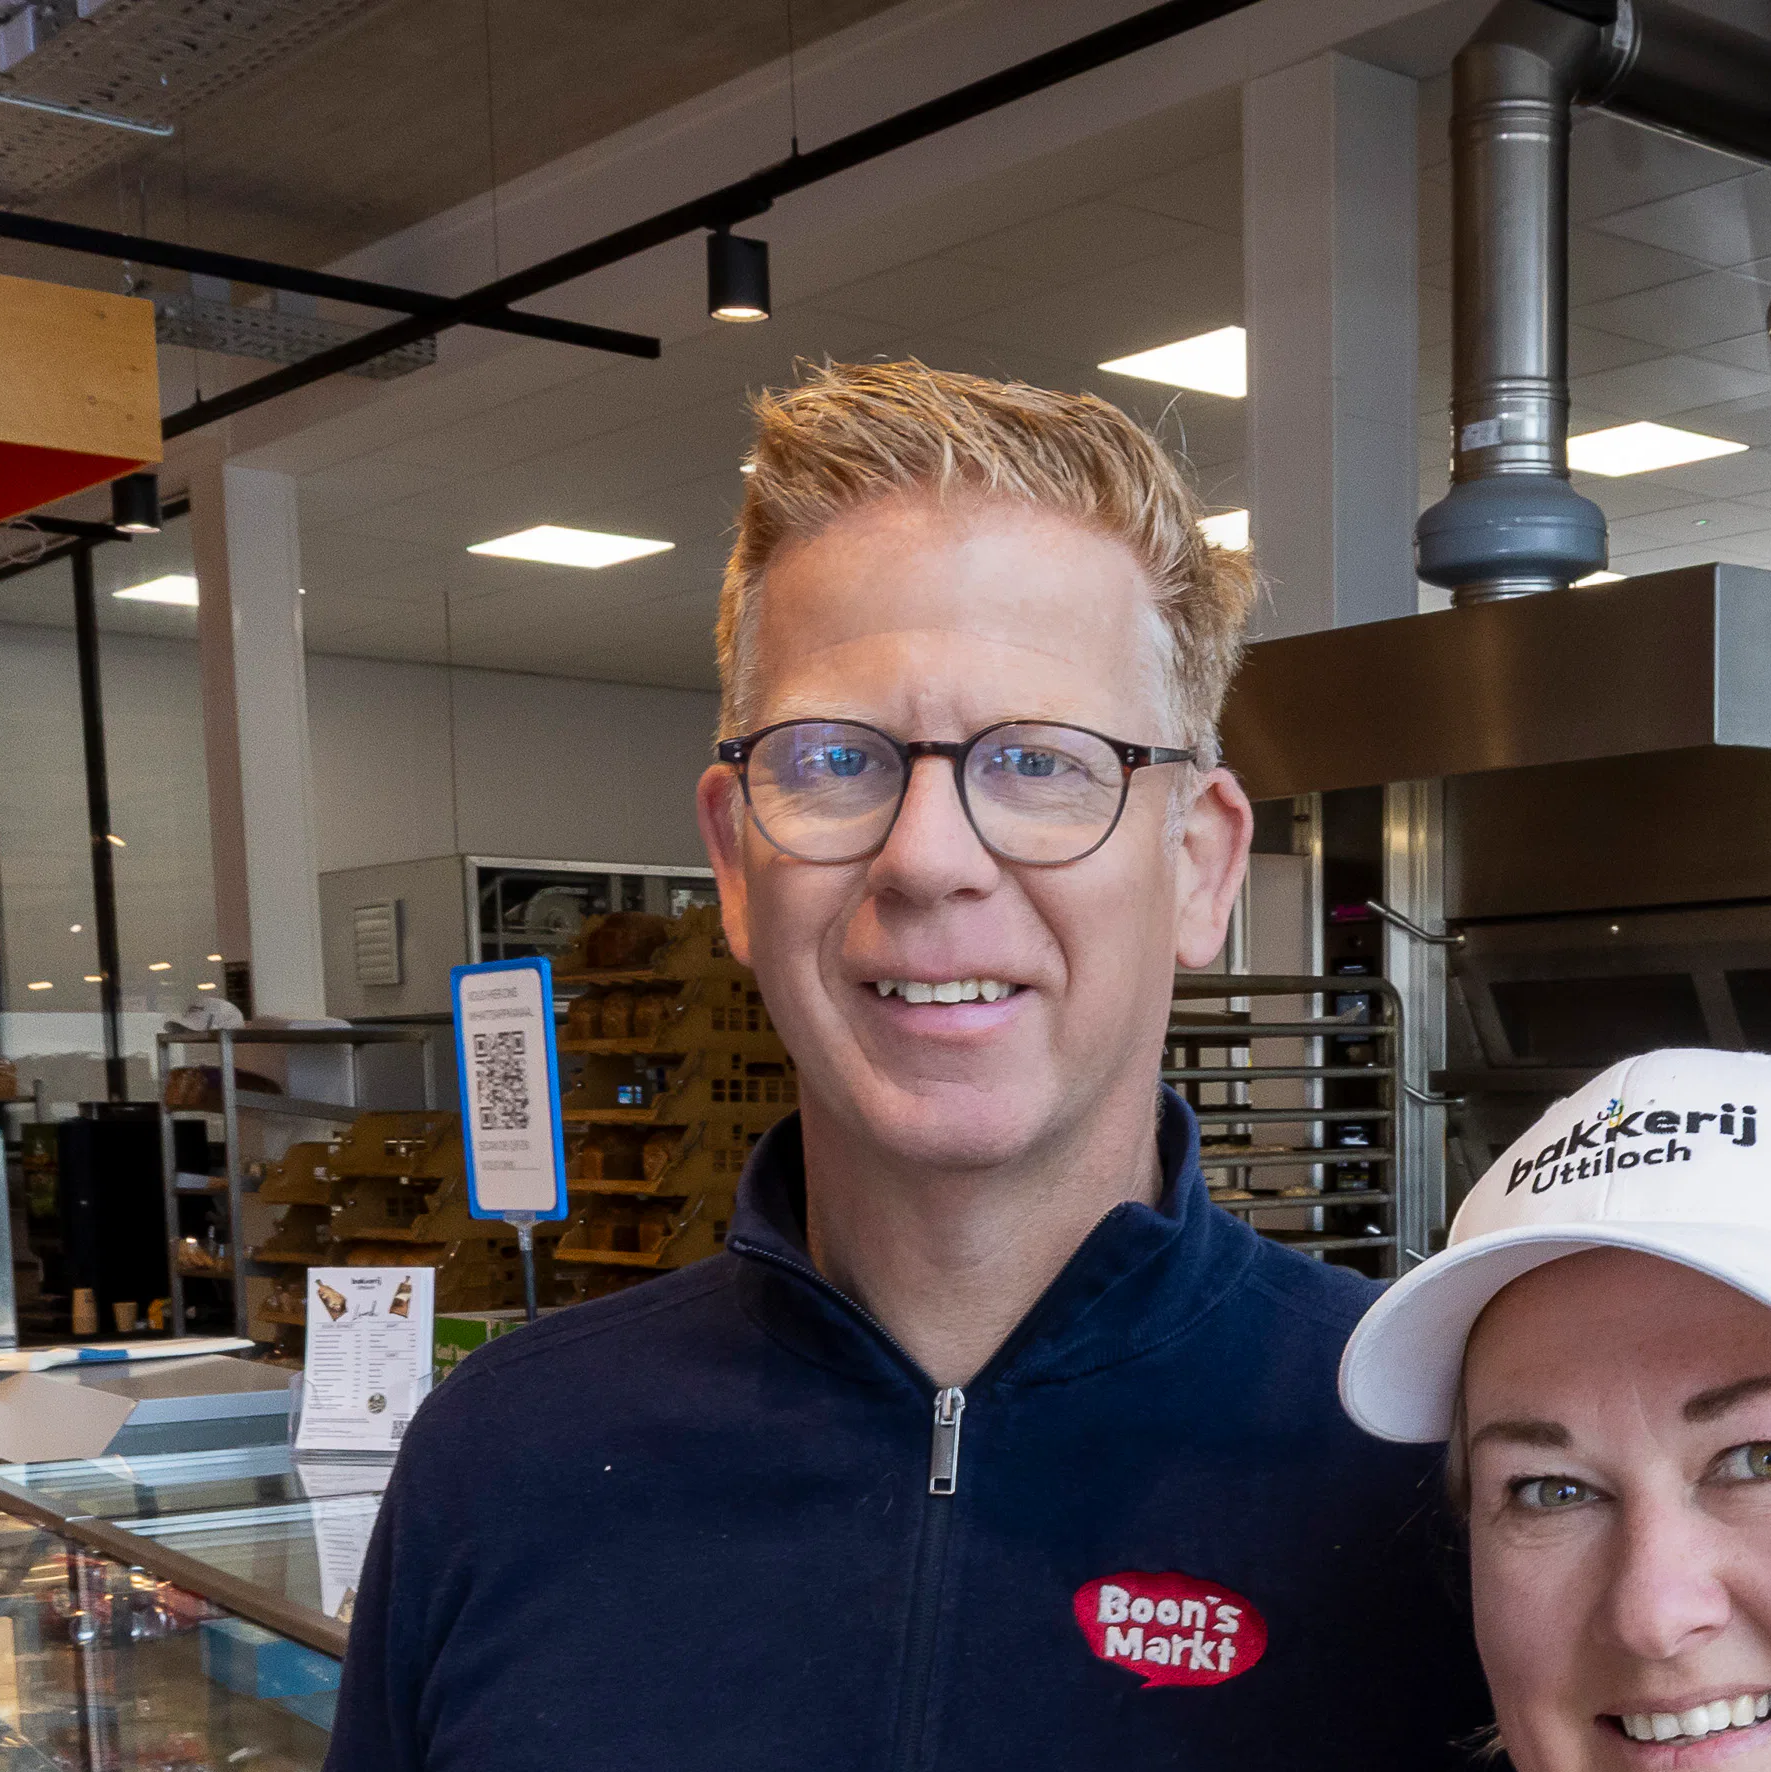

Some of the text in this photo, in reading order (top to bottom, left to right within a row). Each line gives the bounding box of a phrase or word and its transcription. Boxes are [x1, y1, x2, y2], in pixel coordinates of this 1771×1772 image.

[1505, 1102, 1757, 1197] bakkerij
[1531, 1138, 1692, 1195] Uttiloch
[1097, 1584, 1243, 1634] Boon's
[1104, 1625, 1237, 1673] Markt
